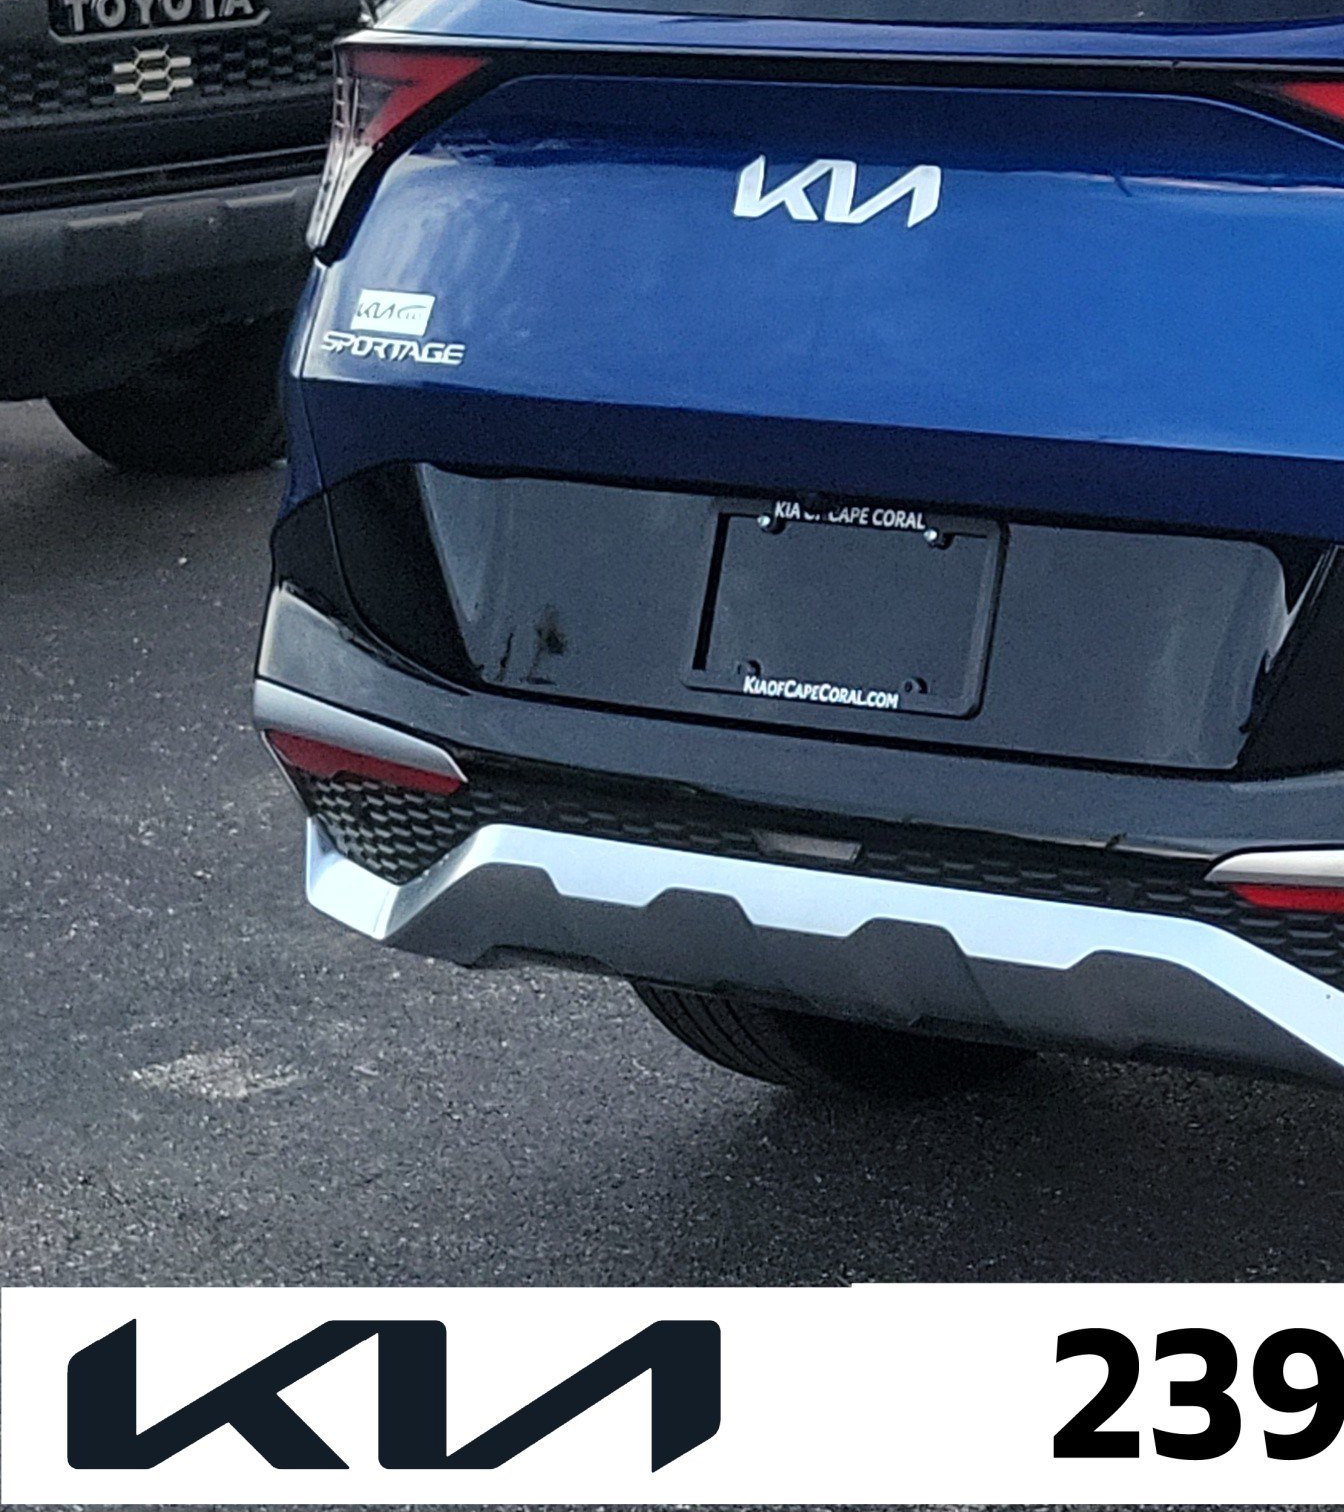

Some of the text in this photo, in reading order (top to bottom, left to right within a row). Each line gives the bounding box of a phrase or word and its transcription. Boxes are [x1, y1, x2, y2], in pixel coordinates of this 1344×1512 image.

[733, 154, 942, 228] KIA
[320, 331, 466, 366] SPORTAGE
[774, 500, 800, 520] KIA
[871, 508, 926, 530] CORAL
